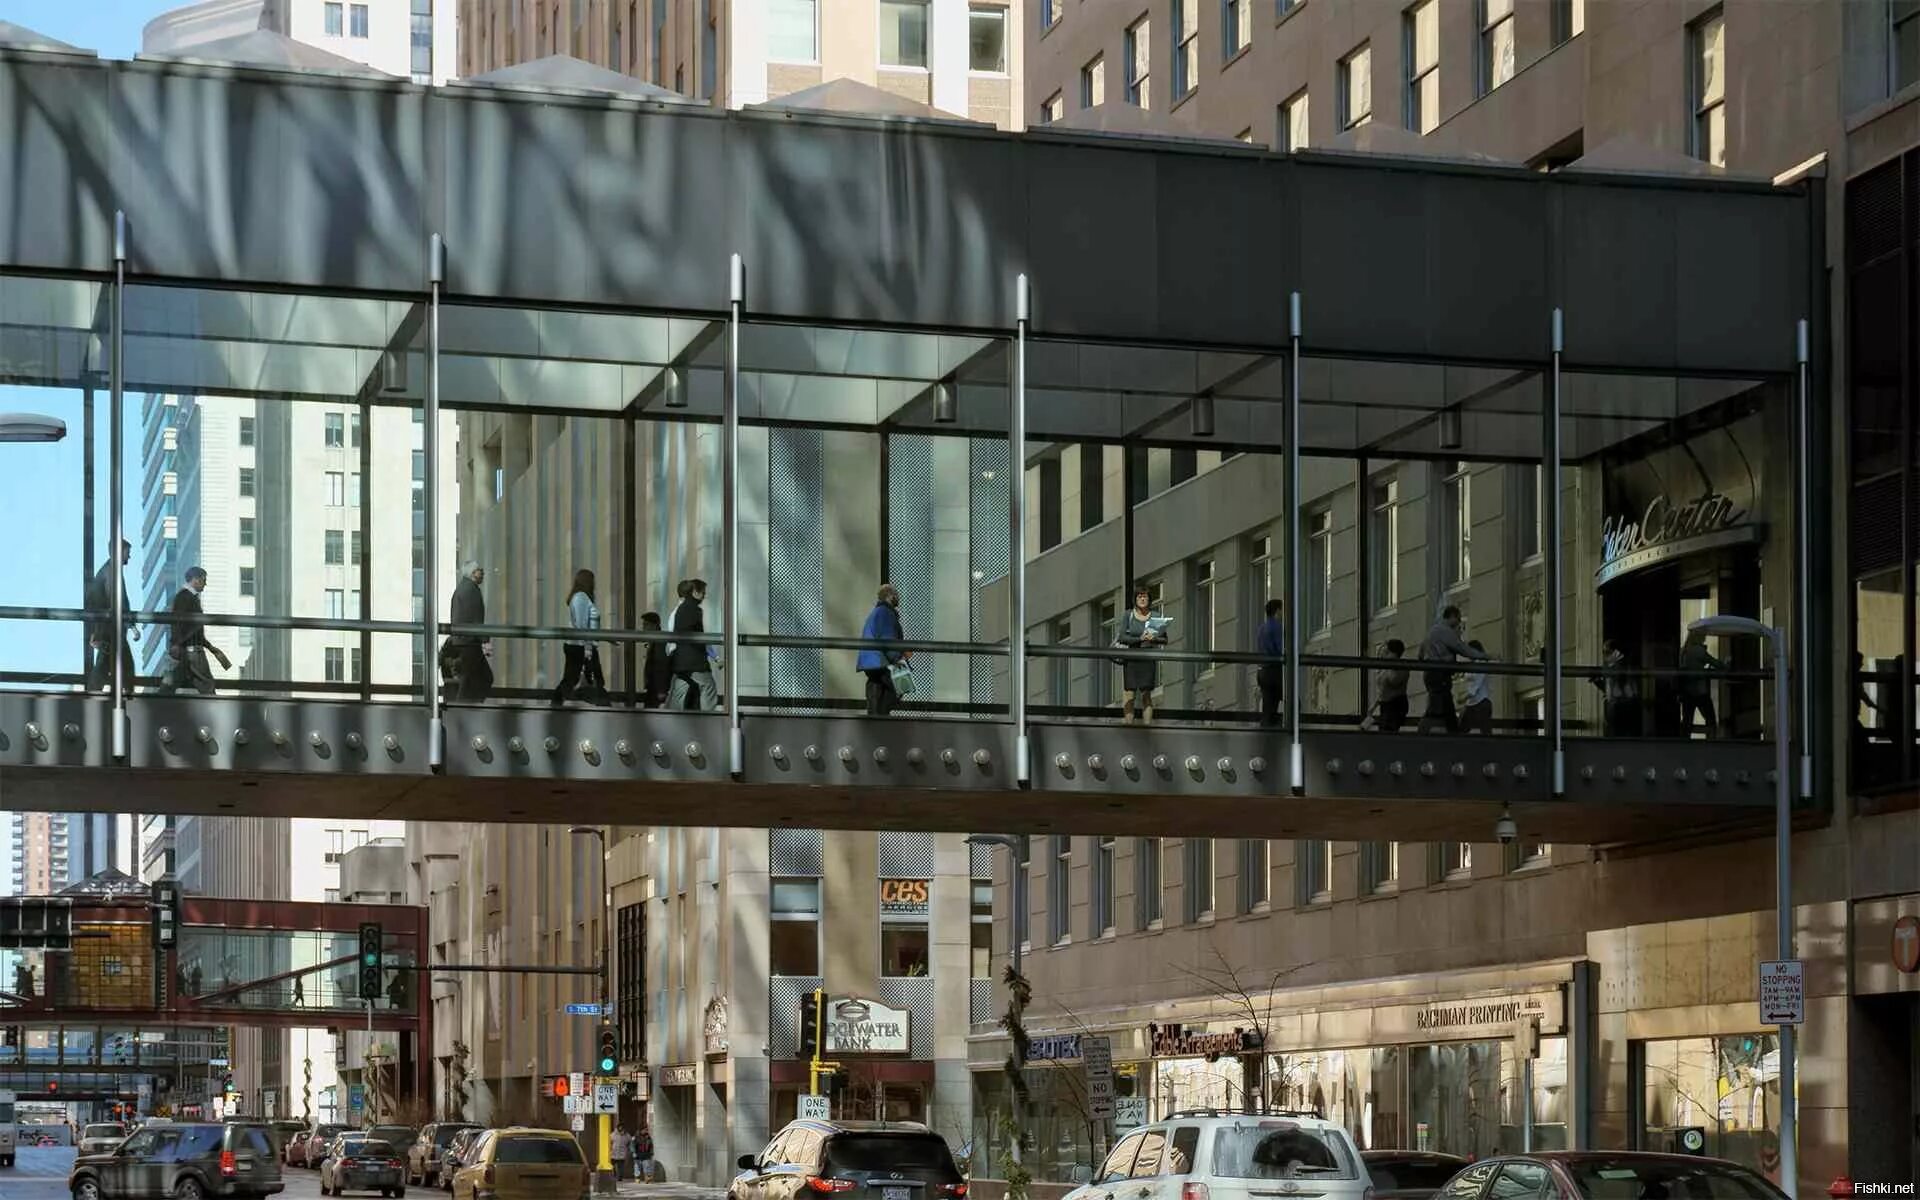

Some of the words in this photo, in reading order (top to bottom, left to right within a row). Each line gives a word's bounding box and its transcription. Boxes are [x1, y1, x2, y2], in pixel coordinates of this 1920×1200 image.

[1776, 964, 1788, 973] NO
[1761, 975, 1801, 985] STOPPING
[1417, 1006, 1467, 1029] BACHMAN
[1469, 1002, 1520, 1025] PRINTING
[827, 1022, 902, 1037] DGEWATER
[834, 1036, 872, 1050] BANK
[598, 1086, 615, 1094] ONE
[1093, 1083, 1107, 1093] NO
[806, 1098, 825, 1108] ONE
[805, 1108, 826, 1119] WAY
